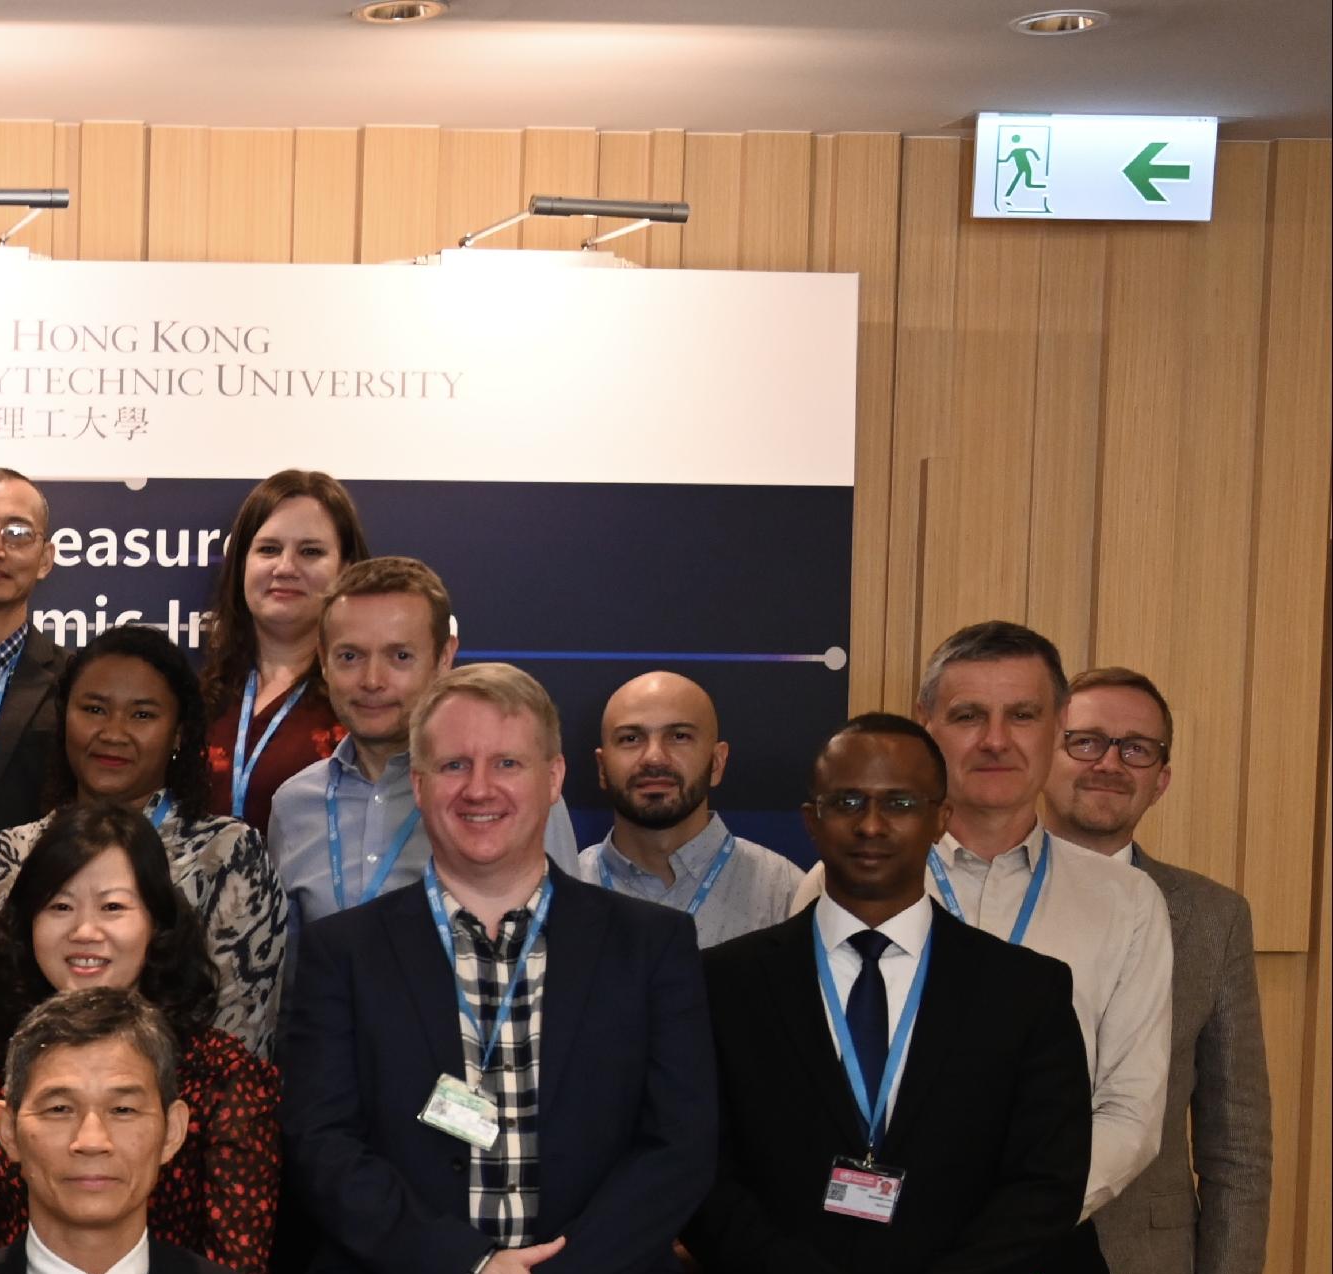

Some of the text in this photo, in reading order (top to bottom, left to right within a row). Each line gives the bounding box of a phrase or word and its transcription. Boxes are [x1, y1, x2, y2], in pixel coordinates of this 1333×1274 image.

[12, 318, 138, 353] HONG
[149, 319, 273, 354] KONG
[215, 363, 466, 399] UNIVERSITY
[50, 527, 234, 567] easur
